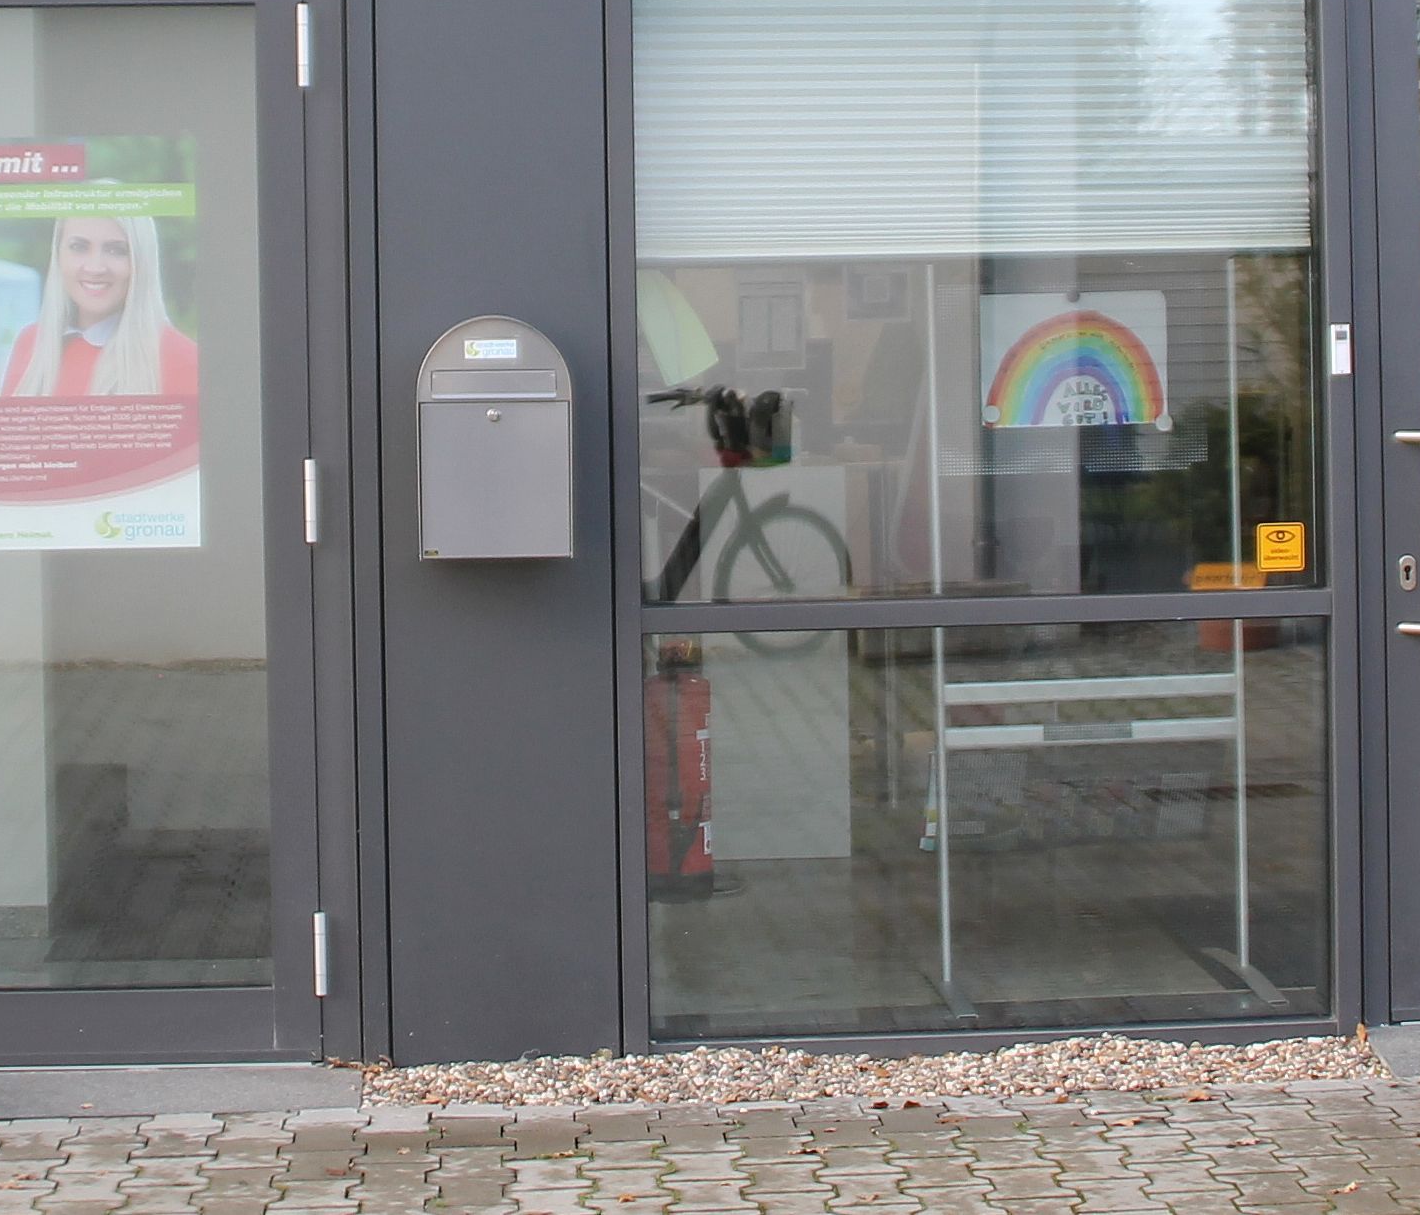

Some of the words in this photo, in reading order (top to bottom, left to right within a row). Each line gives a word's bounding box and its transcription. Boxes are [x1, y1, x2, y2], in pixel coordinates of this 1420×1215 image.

[1063, 380, 1108, 401] ALLES
[1057, 398, 1104, 414] WIRD
[18, 461, 42, 469] mobil
[114, 511, 185, 524] stadtwerke
[125, 523, 185, 541] gronau
[700, 754, 706, 767] 2
[700, 767, 706, 781] 3
